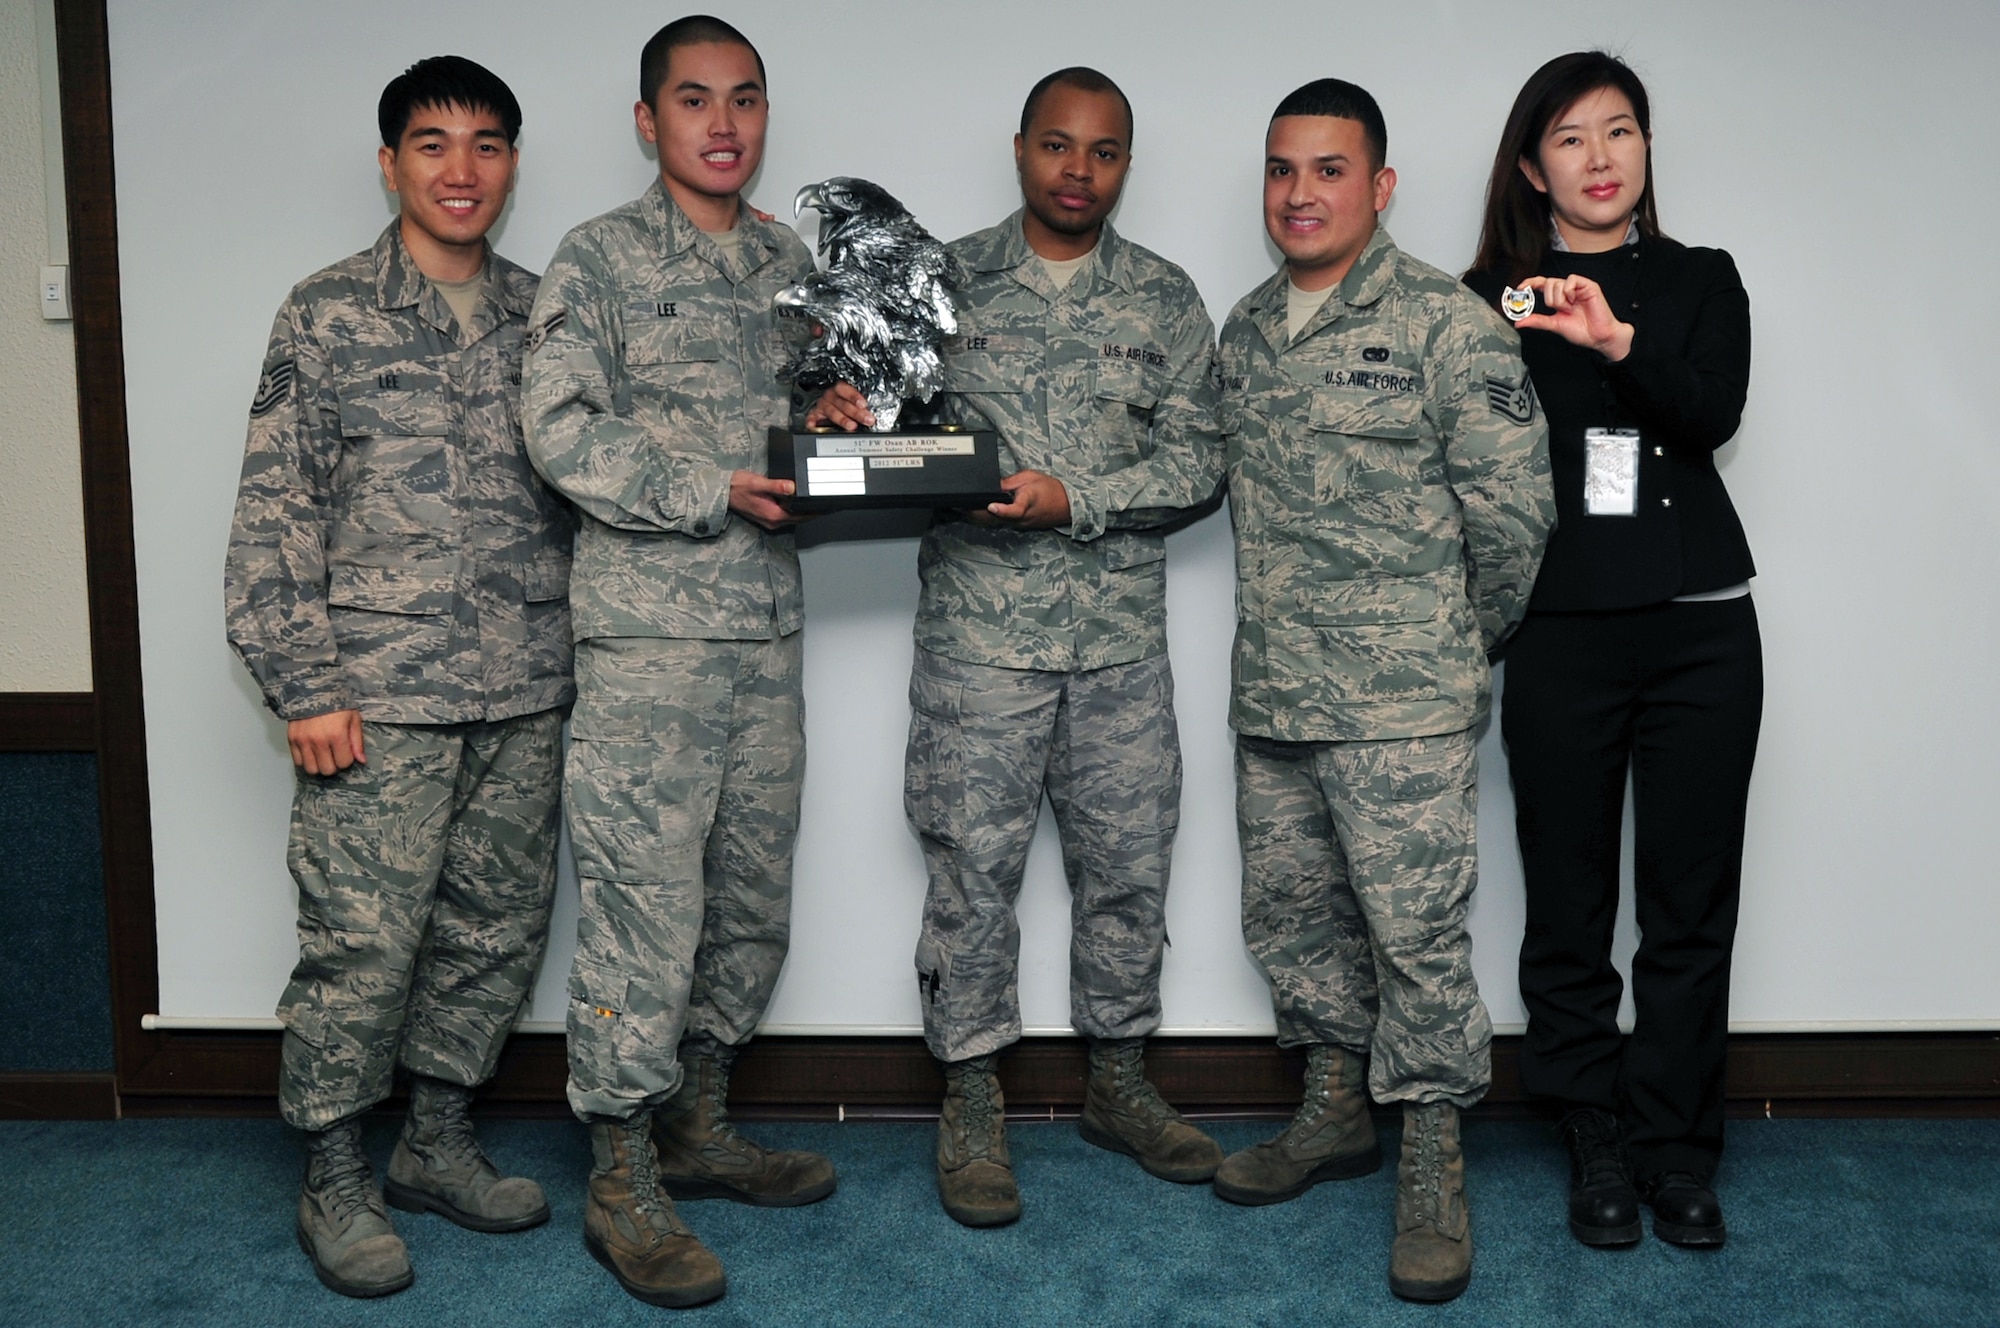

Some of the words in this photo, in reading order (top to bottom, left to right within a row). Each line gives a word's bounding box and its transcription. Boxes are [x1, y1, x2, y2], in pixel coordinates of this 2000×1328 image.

[657, 302, 678, 317] LEE
[967, 337, 987, 350] LEE
[1104, 344, 1123, 358] U.S.
[1126, 347, 1141, 361] AIR
[1142, 350, 1166, 367] FORCE
[378, 374, 400, 389] LEE
[1325, 371, 1345, 386] U.S.
[1347, 372, 1369, 387] AIR
[1373, 374, 1415, 392] FORCE
